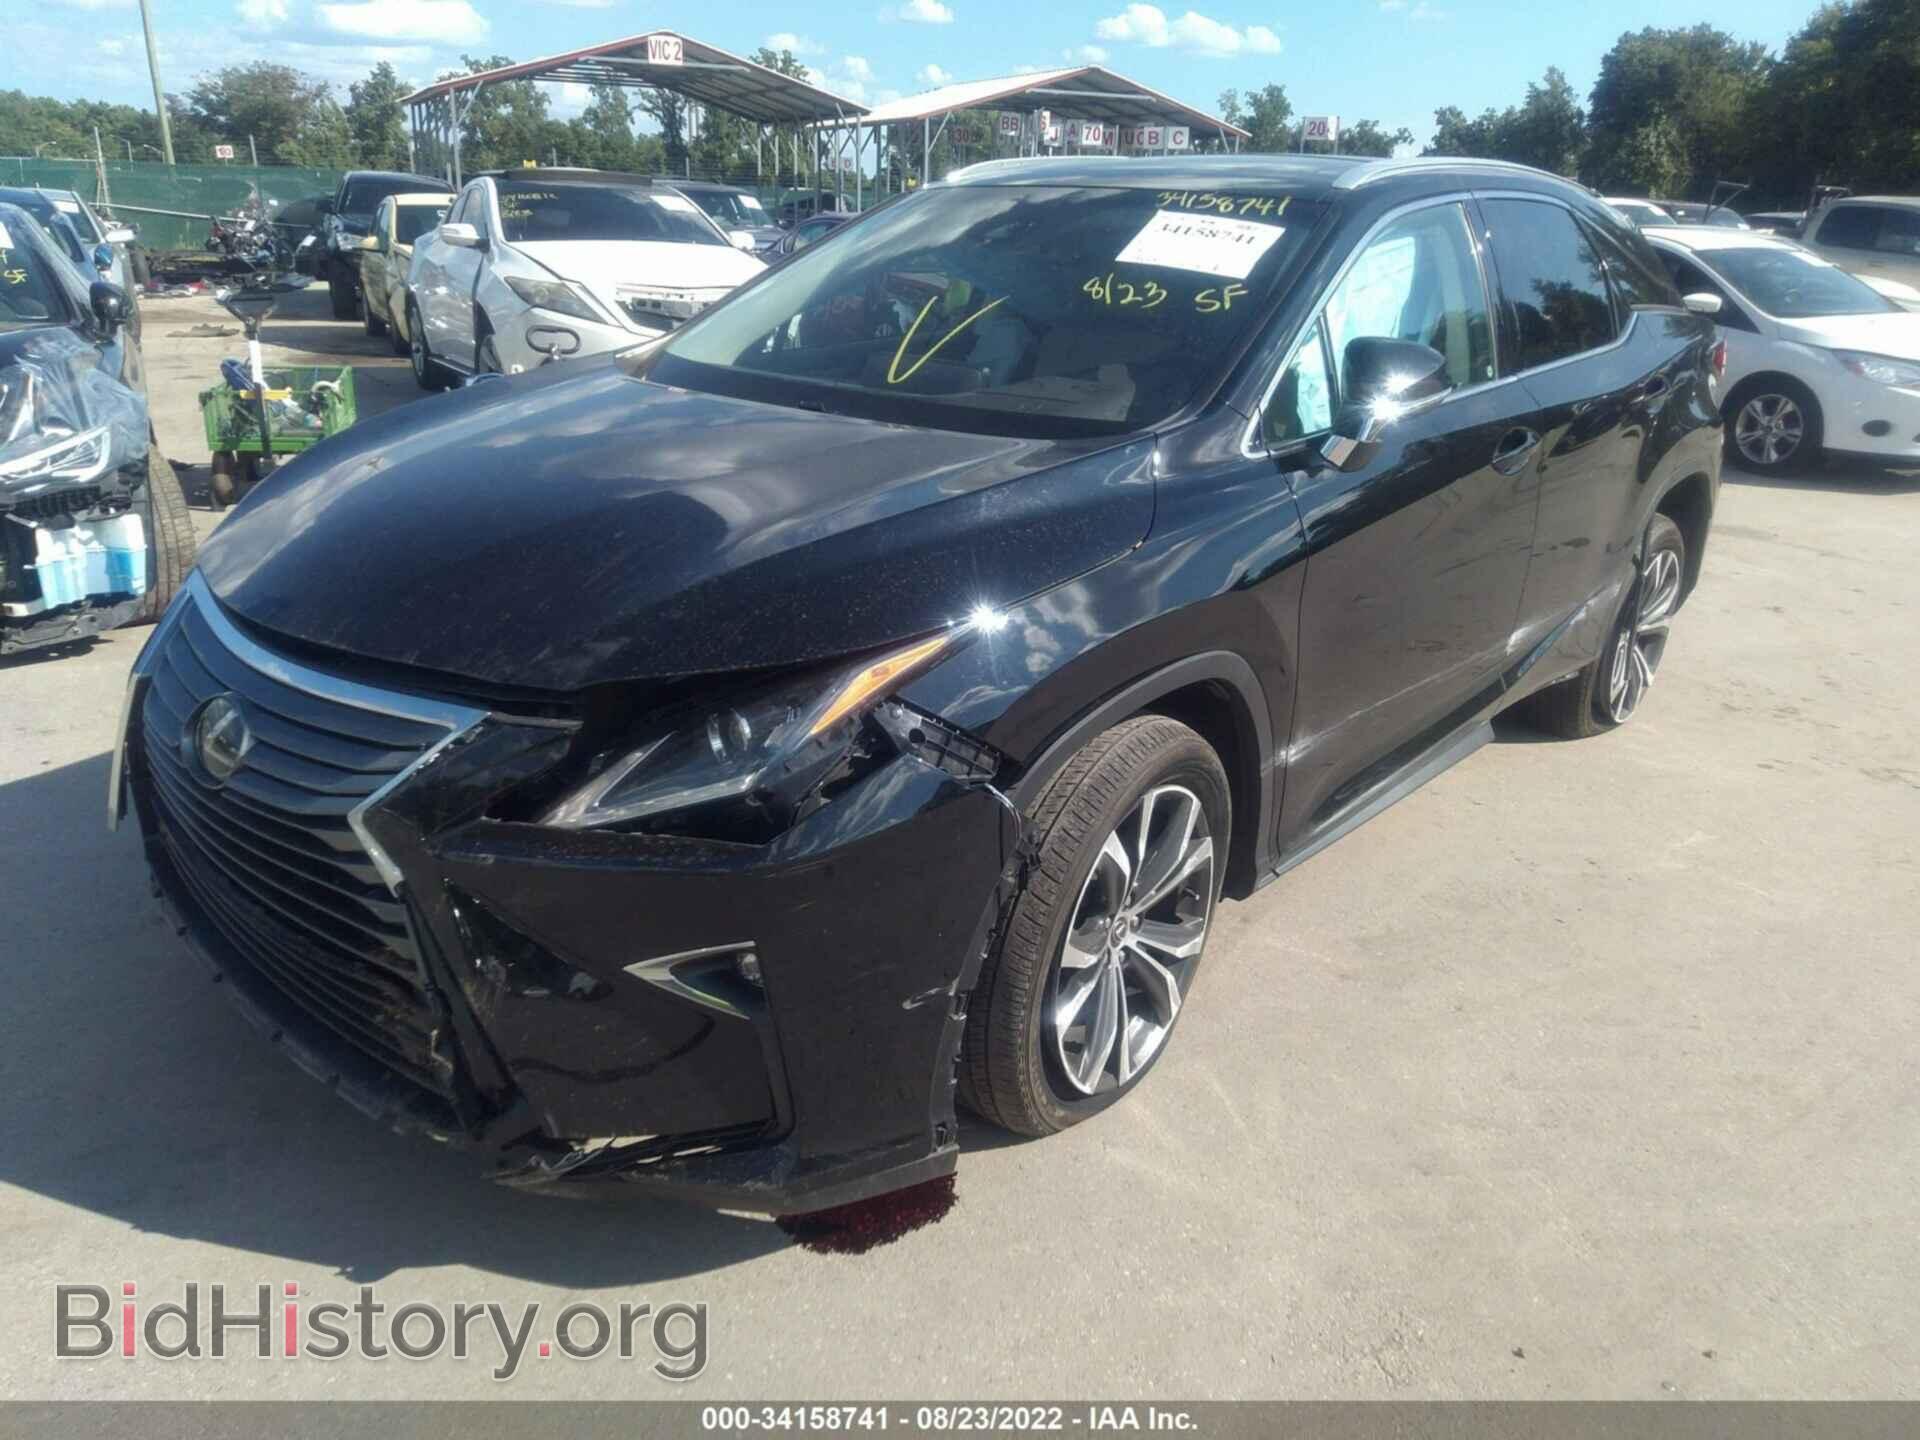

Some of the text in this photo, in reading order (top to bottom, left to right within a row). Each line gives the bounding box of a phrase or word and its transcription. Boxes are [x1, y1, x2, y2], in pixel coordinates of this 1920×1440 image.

[650, 39, 682, 61] VIC 2
[1001, 115, 1020, 131] BB
[1085, 126, 1101, 142] 70
[1148, 130, 1160, 145] B
[1172, 130, 1184, 145] C
[1154, 191, 1293, 216] 34158741
[1194, 283, 1248, 312] SF
